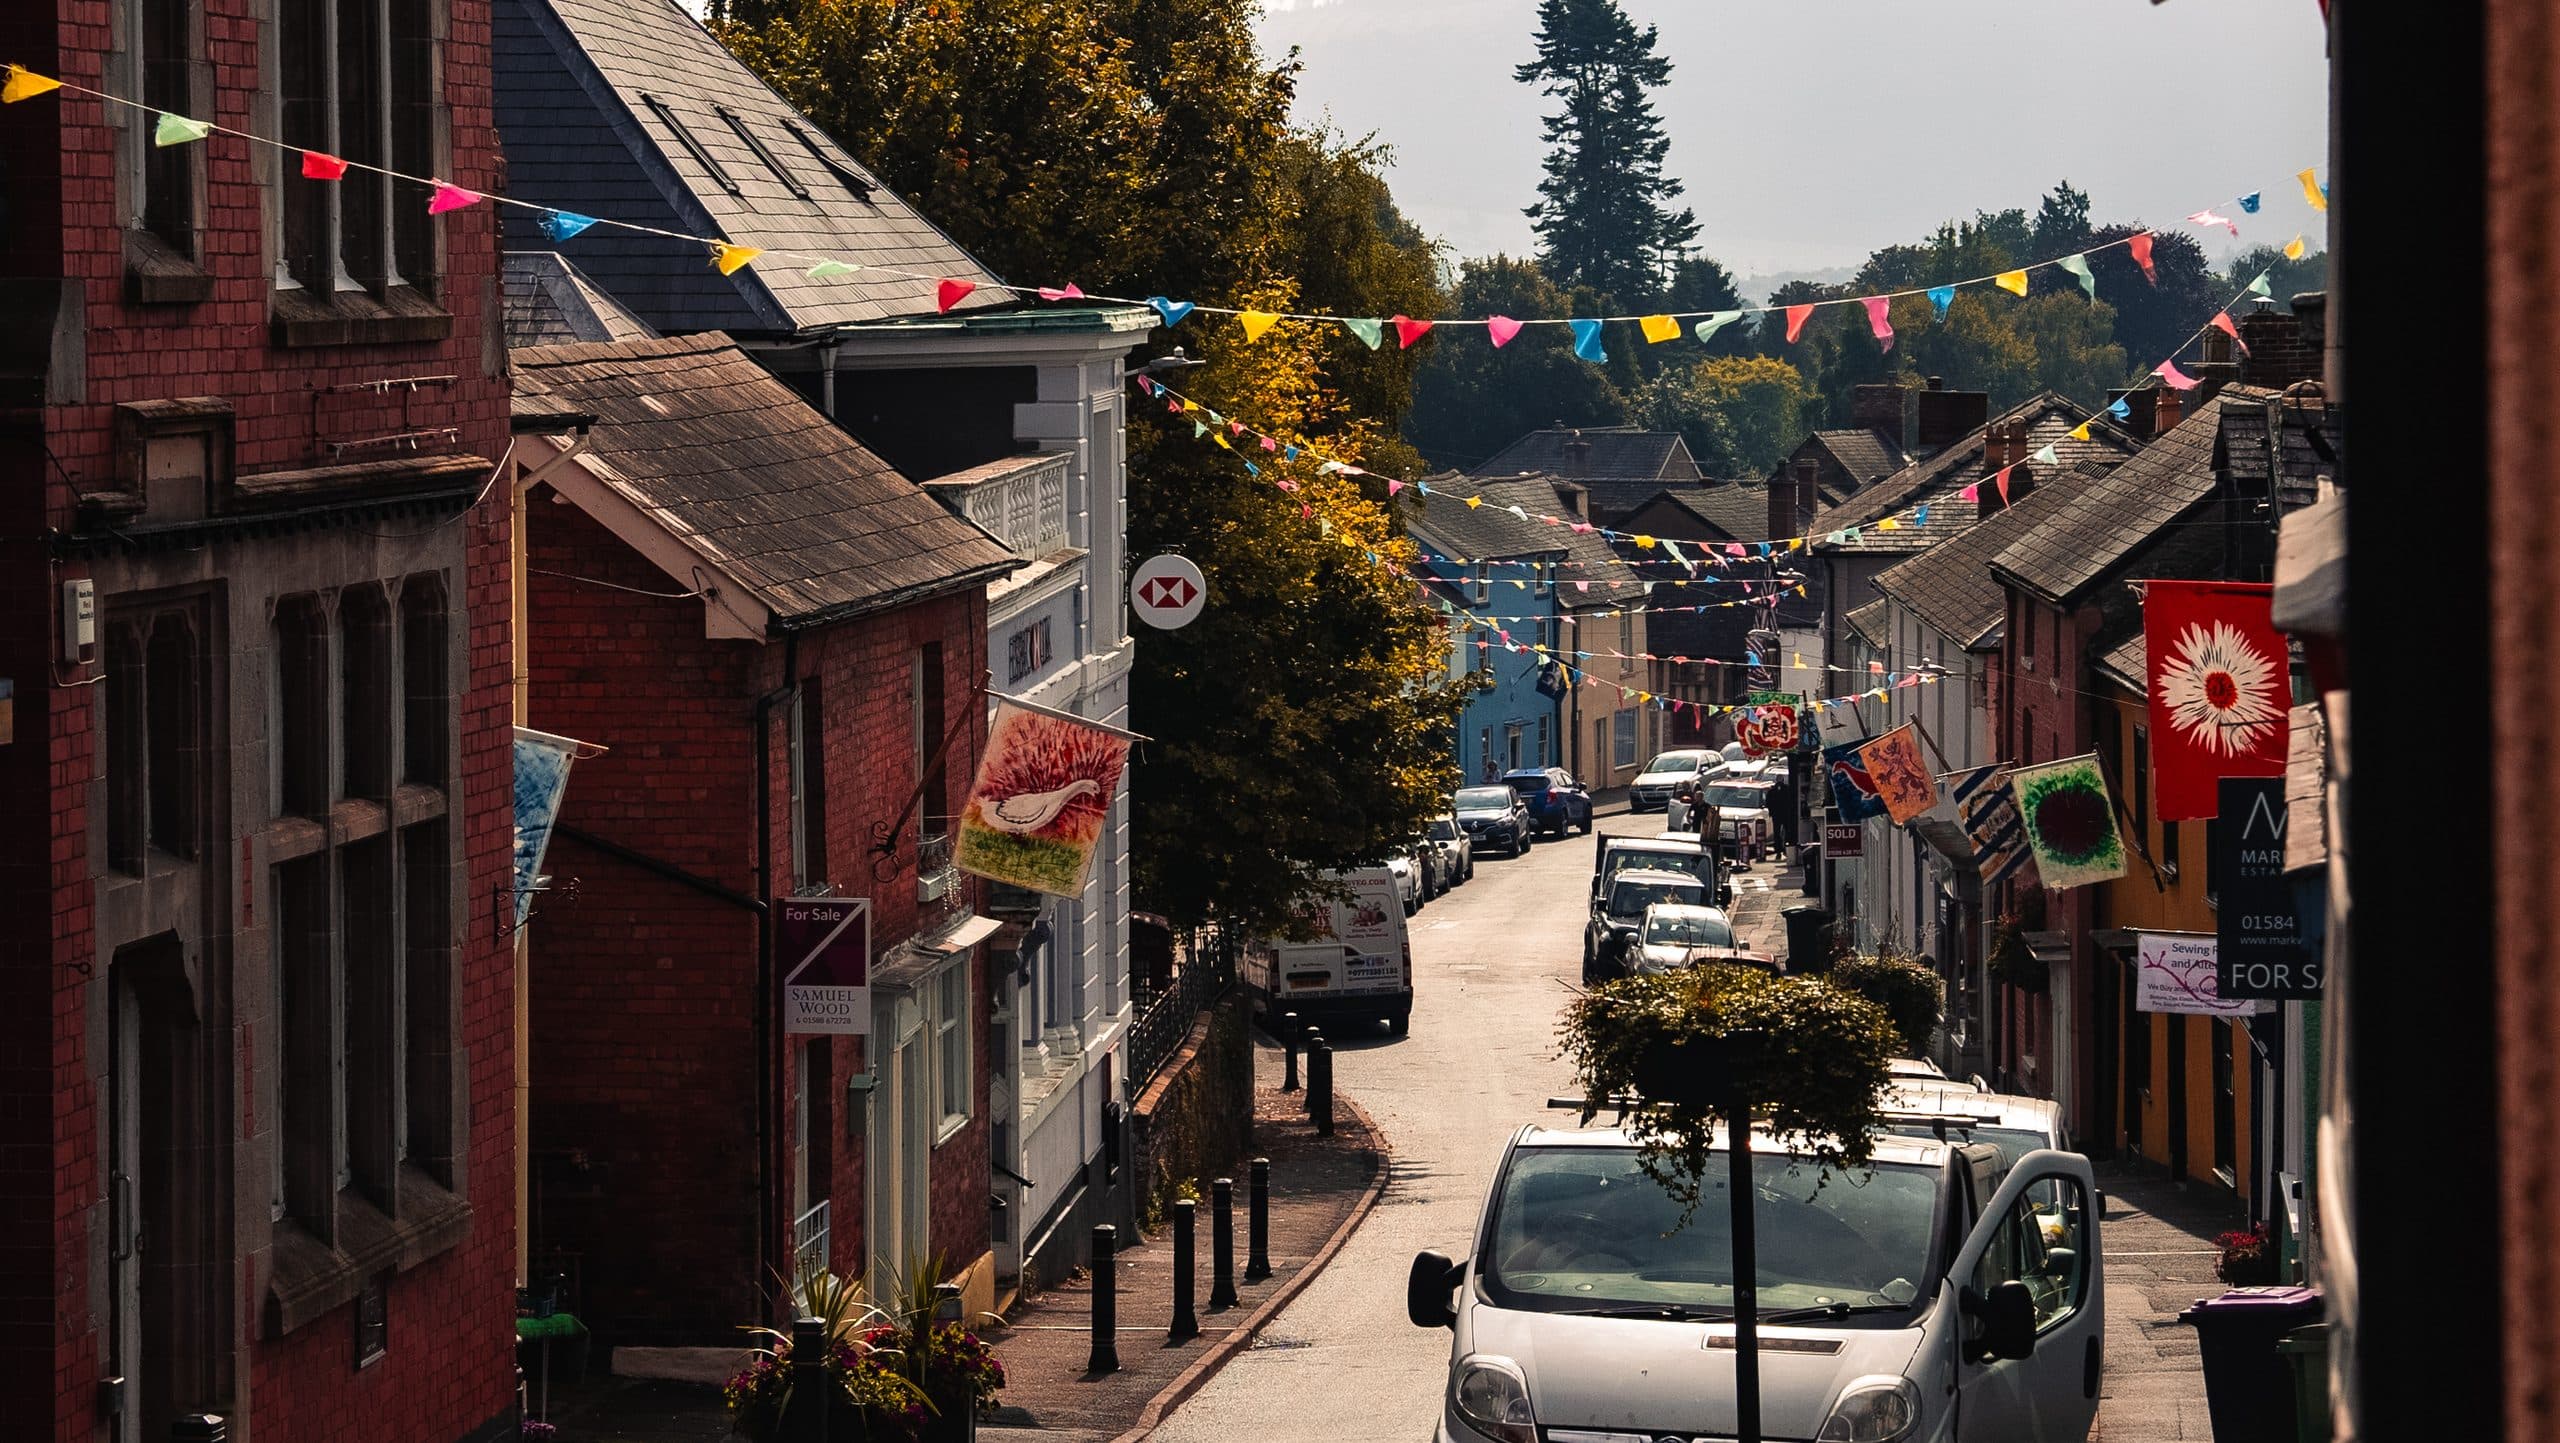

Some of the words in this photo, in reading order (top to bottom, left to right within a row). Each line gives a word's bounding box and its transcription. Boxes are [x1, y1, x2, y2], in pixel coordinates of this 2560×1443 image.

[1828, 829, 1856, 839] SOLD
[2241, 849, 2286, 864] MAR
[786, 908, 808, 921] For
[812, 908, 841, 921] Sale
[2241, 915, 2294, 930] 01584
[2171, 943, 2210, 957] Sewing
[2171, 959, 2191, 969] and
[2192, 959, 2217, 970] Alte
[2232, 963, 2292, 989] FOR
[792, 989, 856, 1002] SAMUEL
[799, 1002, 850, 1015] WOOD
